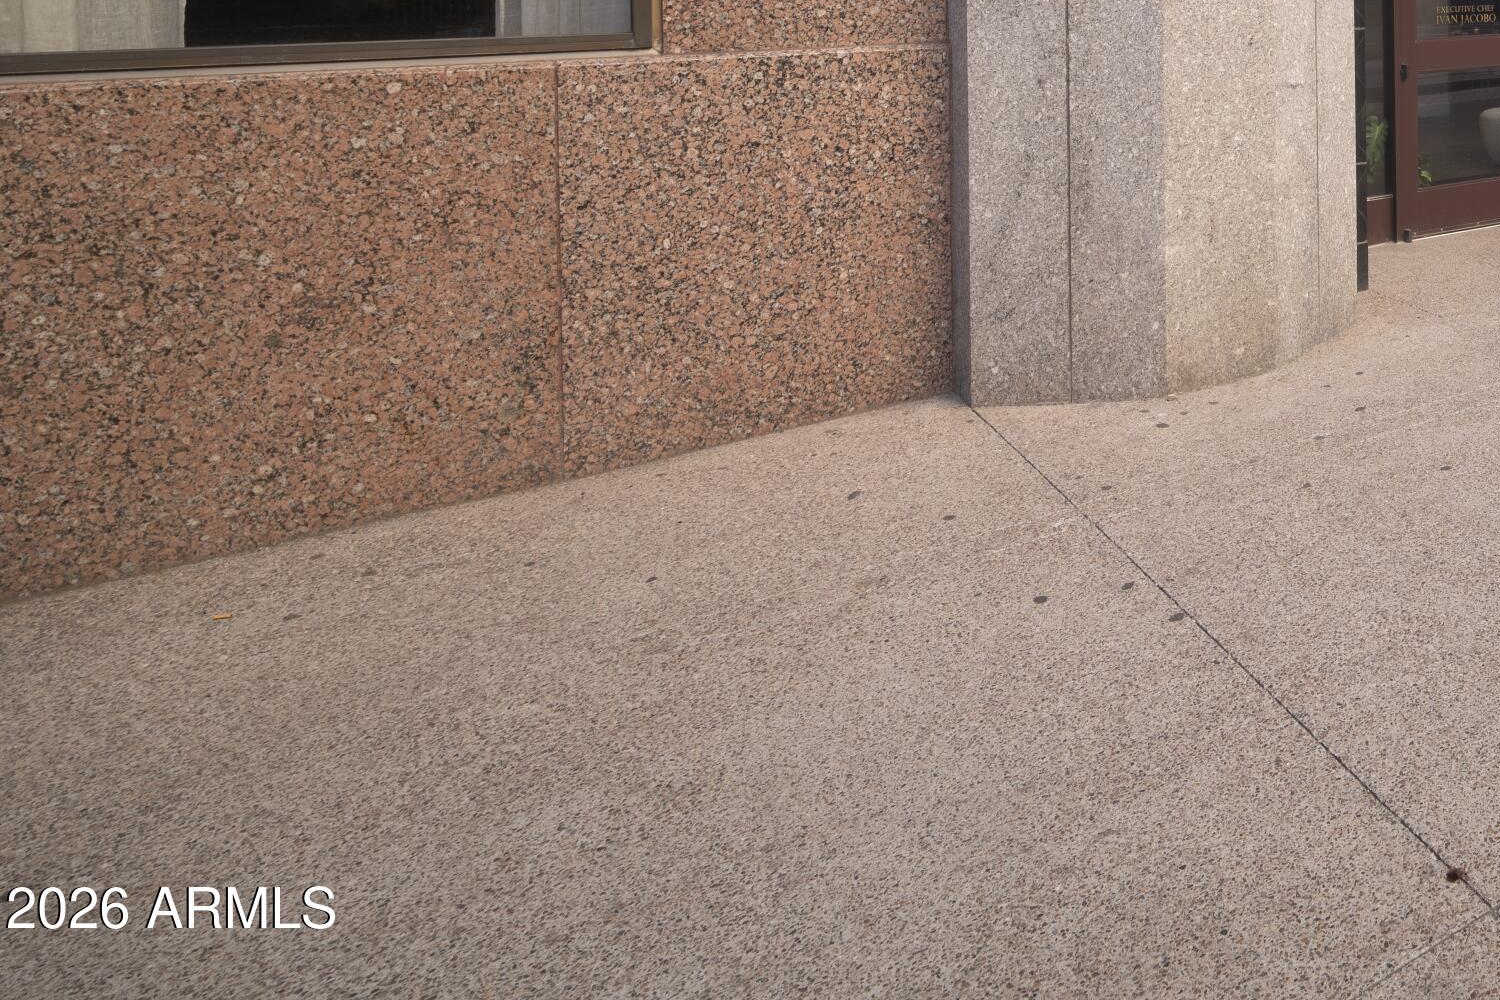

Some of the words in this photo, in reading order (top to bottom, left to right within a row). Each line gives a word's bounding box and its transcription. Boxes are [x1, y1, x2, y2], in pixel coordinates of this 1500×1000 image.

[1436, 5, 1475, 14] EXECUTIVE
[1476, 4, 1495, 12] CHEF
[1436, 14, 1458, 25] IVAN
[1460, 13, 1497, 26] JACOBO
